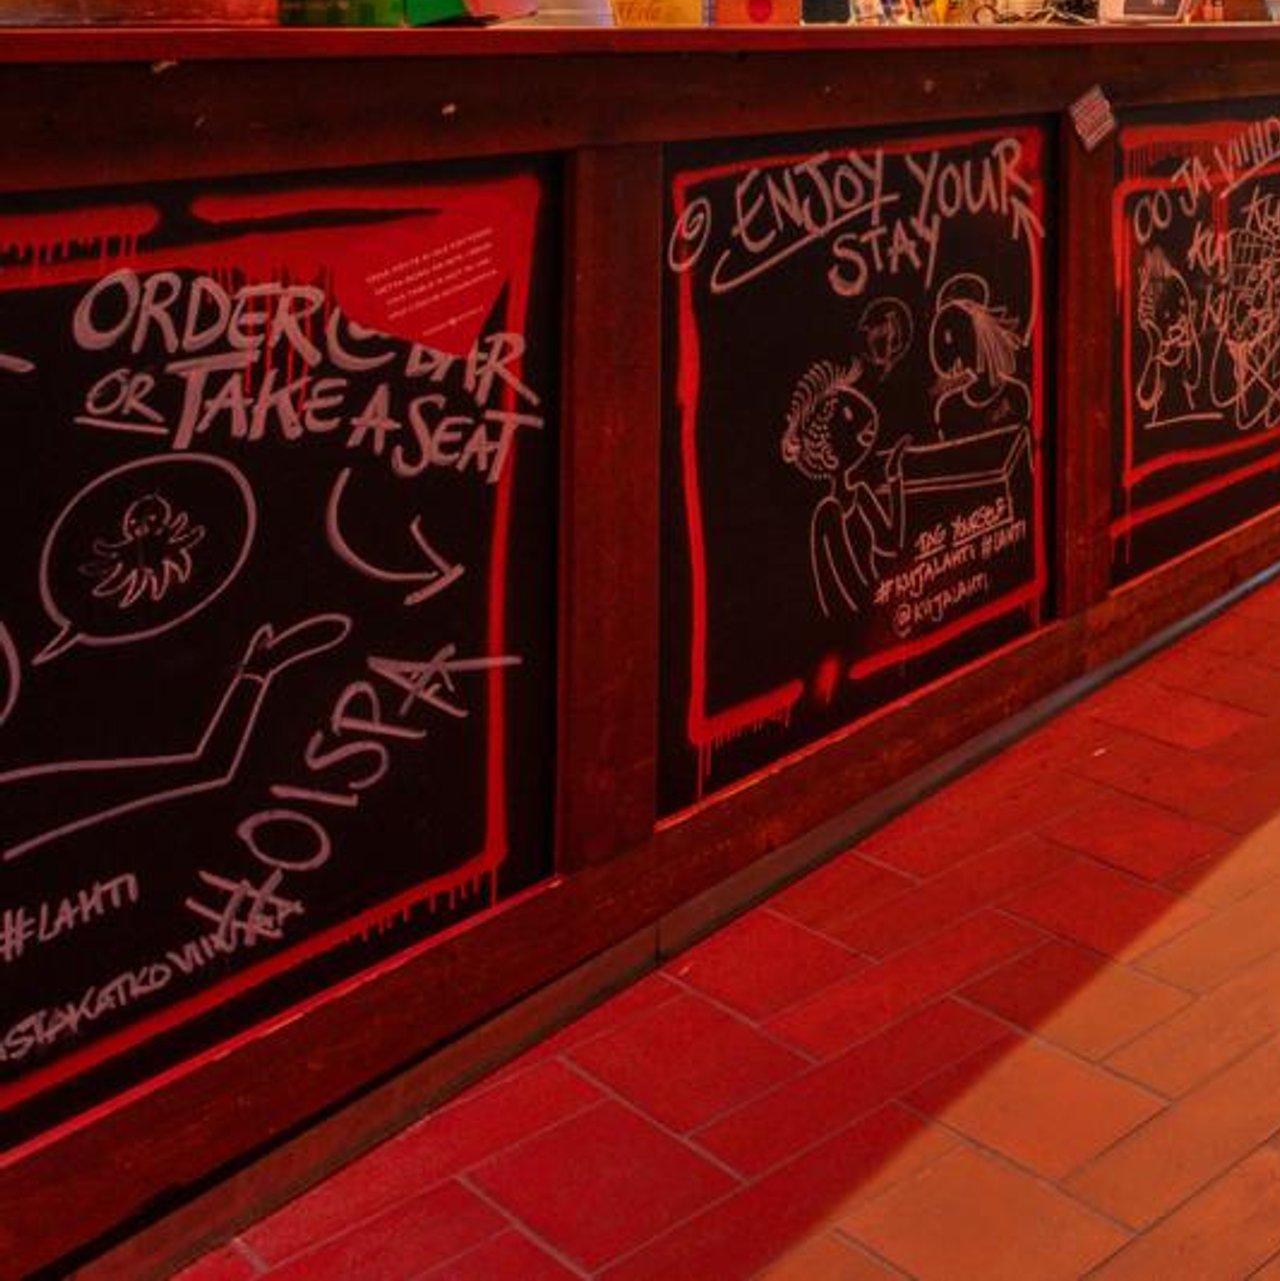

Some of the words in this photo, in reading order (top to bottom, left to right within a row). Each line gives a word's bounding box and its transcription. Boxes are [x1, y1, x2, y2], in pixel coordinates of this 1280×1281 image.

[732, 149, 898, 254] ENJOY
[905, 138, 1033, 238] YOUR
[827, 213, 943, 297] STAY
[72, 267, 323, 368] ORDER
[84, 368, 165, 423] OR
[166, 349, 348, 450] TAKE
[347, 383, 399, 455] A
[391, 394, 543, 483] SEAT
[0, 872, 139, 962] #LAHTI
